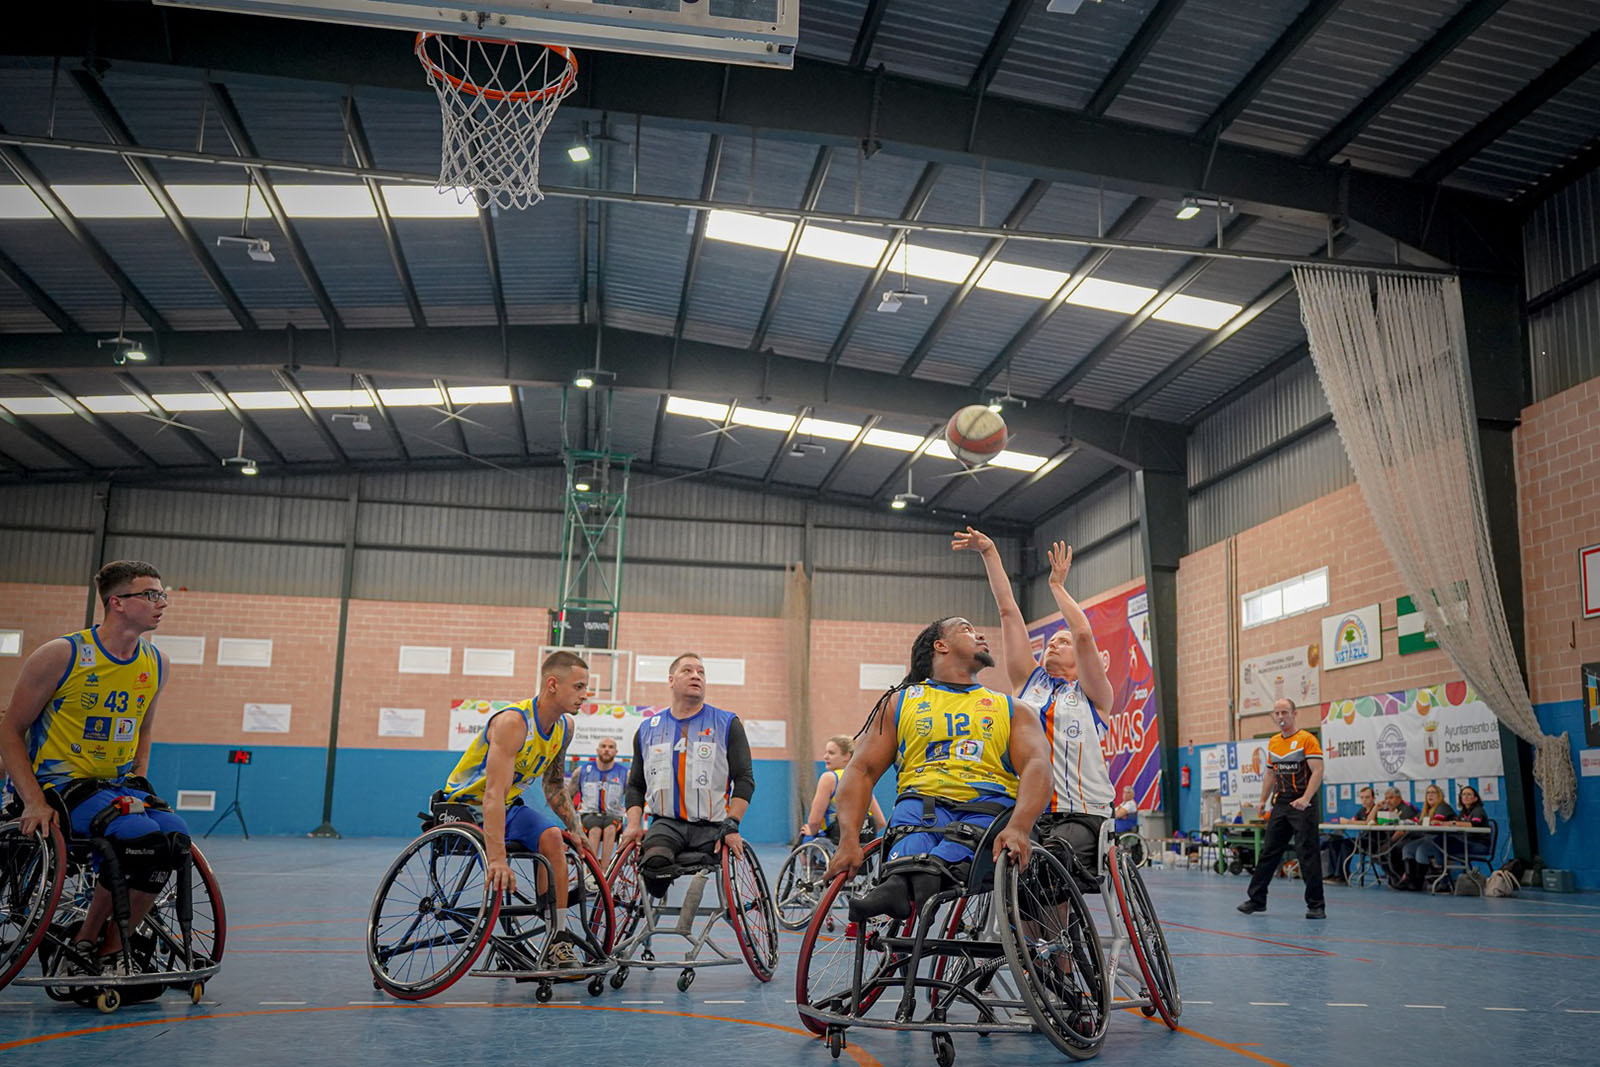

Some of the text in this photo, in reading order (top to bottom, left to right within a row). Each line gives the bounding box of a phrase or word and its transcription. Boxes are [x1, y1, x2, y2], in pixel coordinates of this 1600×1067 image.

[104, 691, 129, 713] 43
[944, 713, 971, 737] 12
[1445, 721, 1489, 738] Ayuntamiento
[674, 738, 687, 753] 4
[1338, 740, 1365, 757] DEPORTE
[1445, 739, 1500, 753] Dos Hermanas
